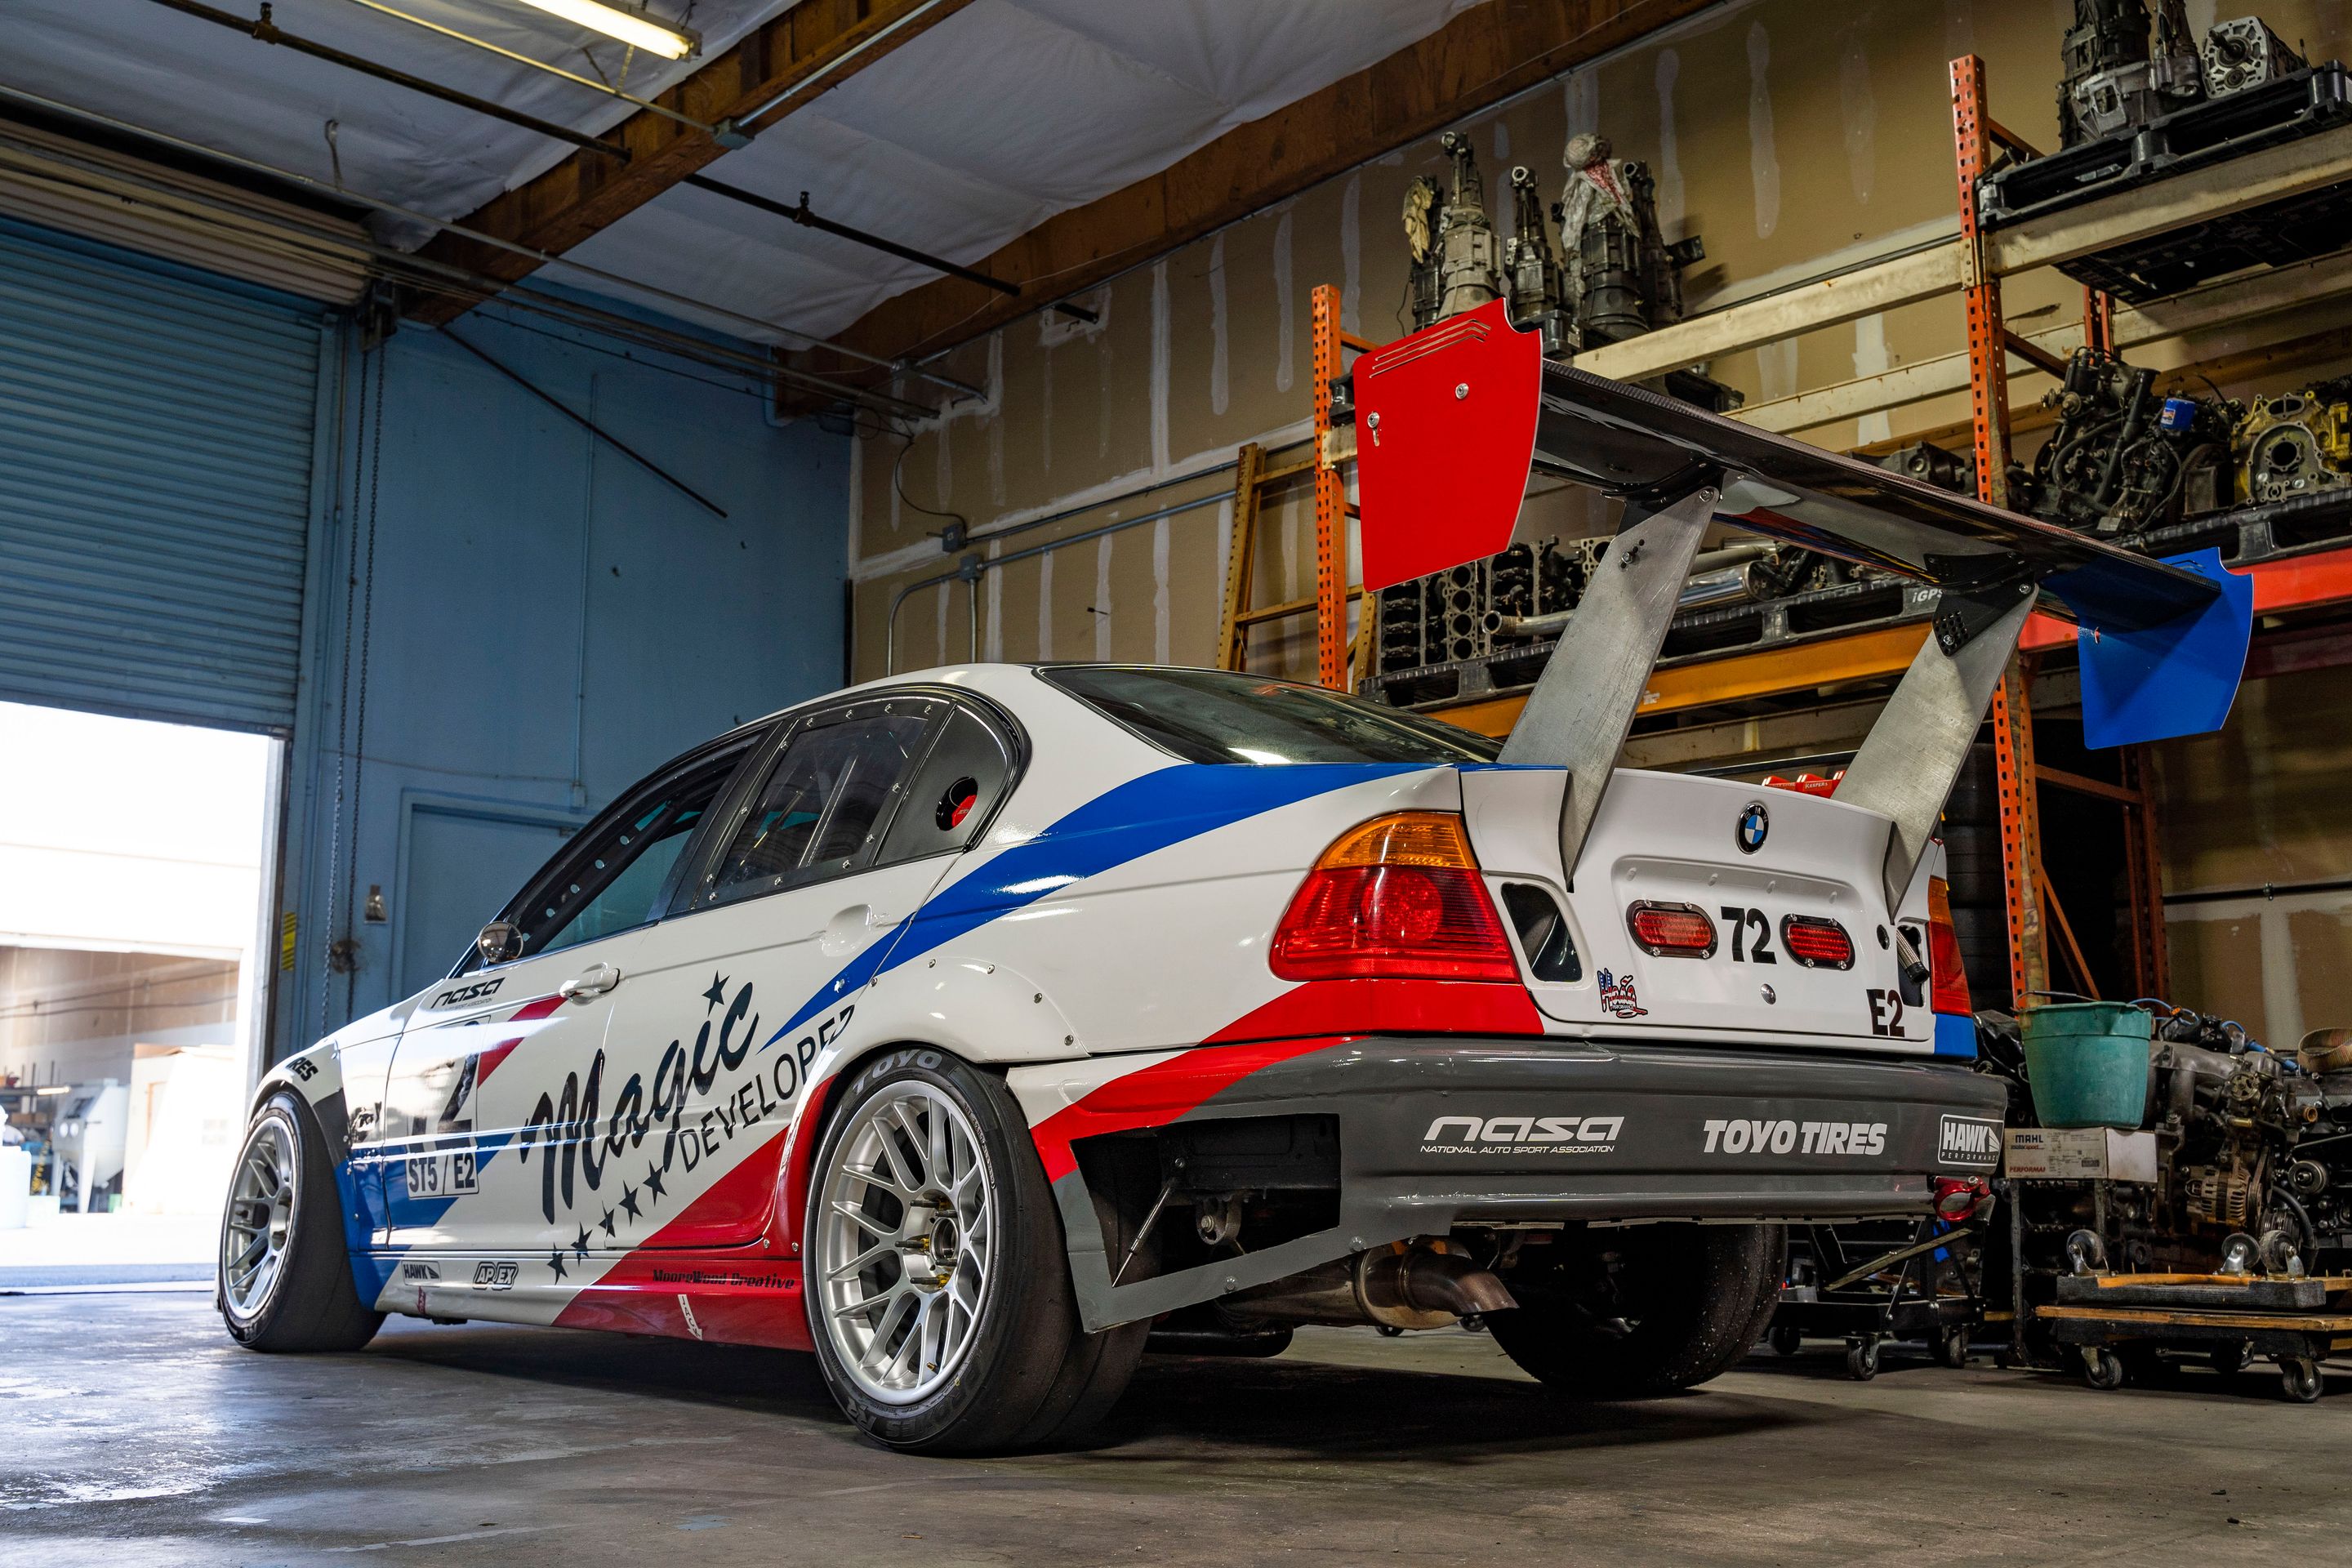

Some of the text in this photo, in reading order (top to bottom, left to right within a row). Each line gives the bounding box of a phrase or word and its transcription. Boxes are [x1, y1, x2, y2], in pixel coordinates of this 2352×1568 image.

[1913, 588, 1943, 603] iGPS
[1721, 906, 1777, 964] 72
[1866, 988, 1905, 1038] E2
[852, 1049, 942, 1095] TOYO
[520, 981, 760, 1225] Magic
[1423, 1116, 1625, 1142] nasa
[1703, 1119, 1888, 1156] TOYO TIRES
[1942, 1121, 1989, 1152] HAWK
[1420, 1145, 1615, 1154] NATIONAL AUTO SPORT ASSOCIATION
[409, 1152, 476, 1193] ST5 E2
[403, 1264, 428, 1280] HAWK
[474, 1264, 516, 1286] APEX
[730, 1272, 795, 1290] Creative
[680, 1295, 701, 1338] JACK
